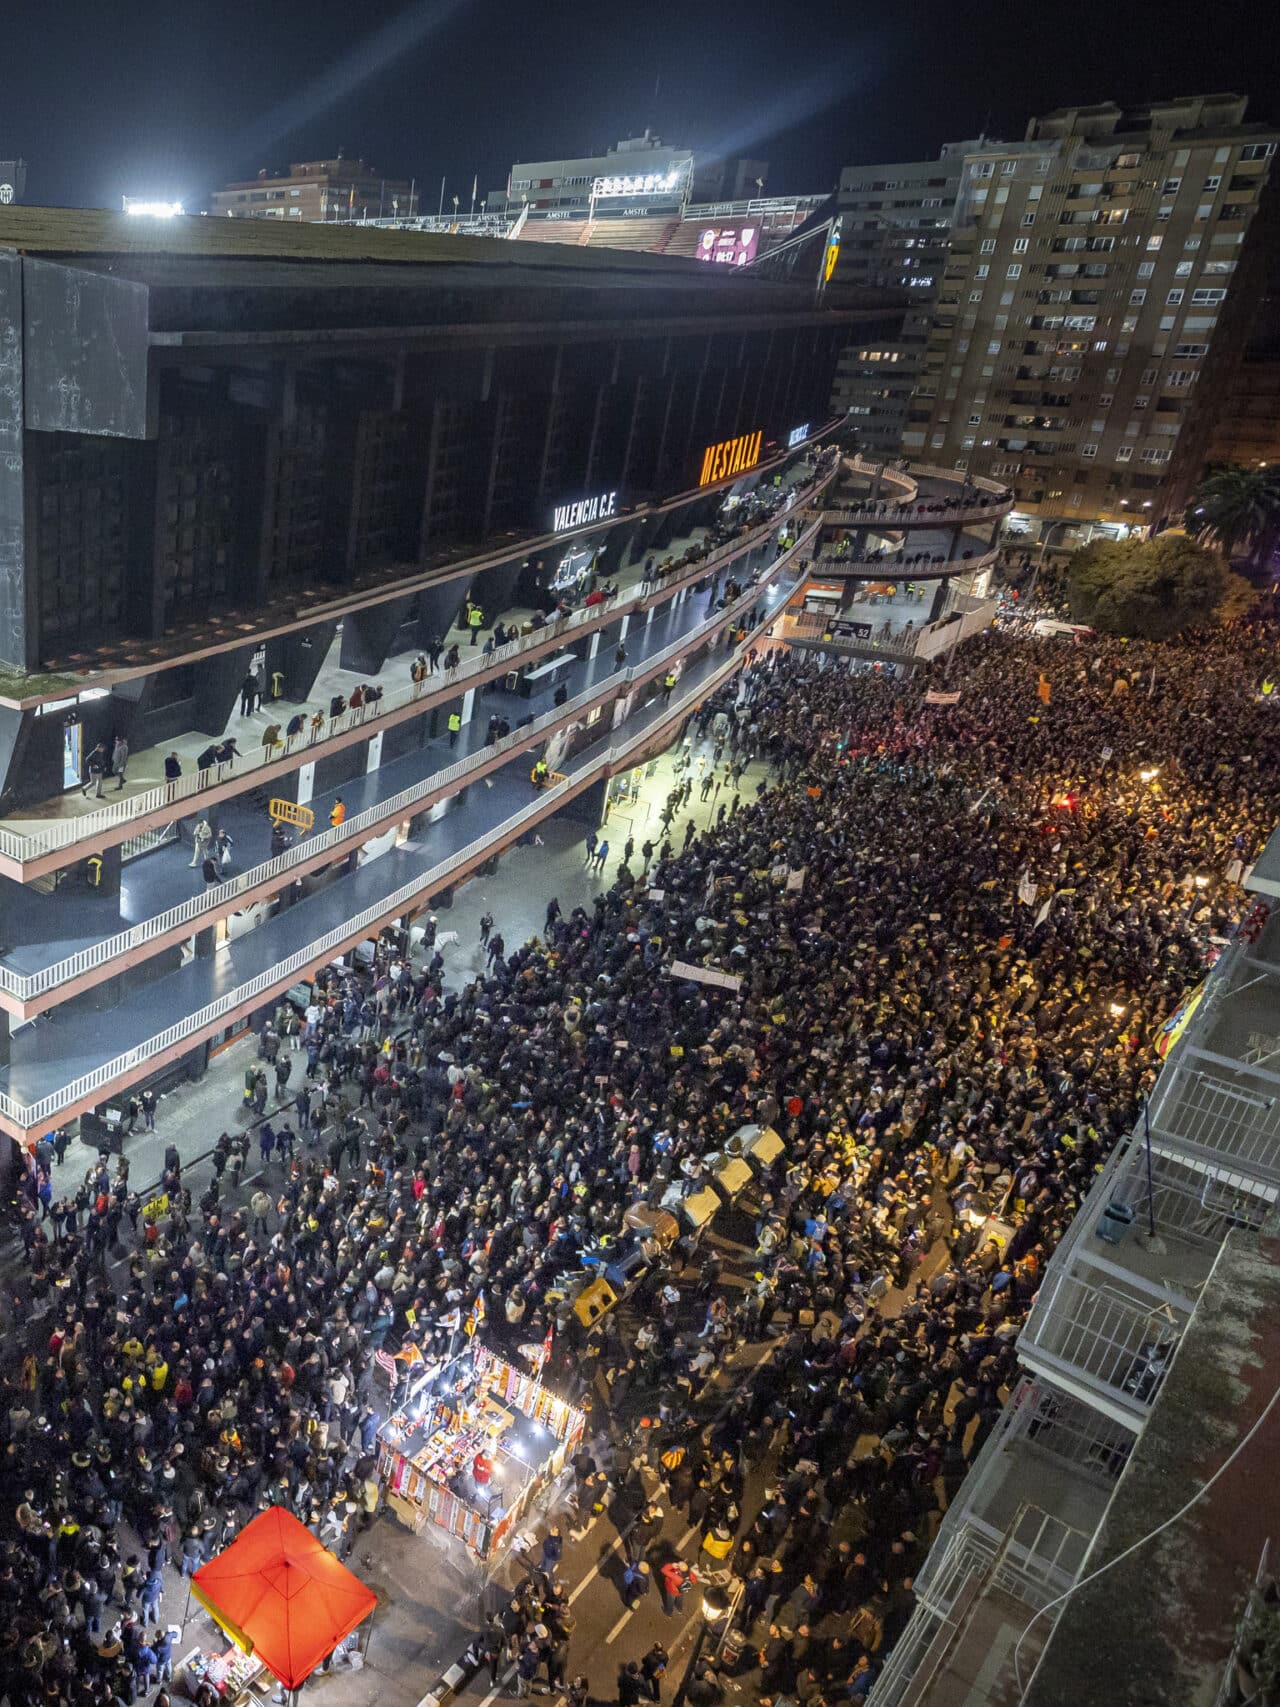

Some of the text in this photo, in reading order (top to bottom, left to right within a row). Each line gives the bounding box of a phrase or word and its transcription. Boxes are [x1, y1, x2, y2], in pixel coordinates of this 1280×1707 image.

[546, 211, 570, 219] AMSTEL
[699, 430, 763, 487] MESTALLA
[554, 491, 616, 532] VALENCIA C.F.
[858, 628, 869, 638] 52
